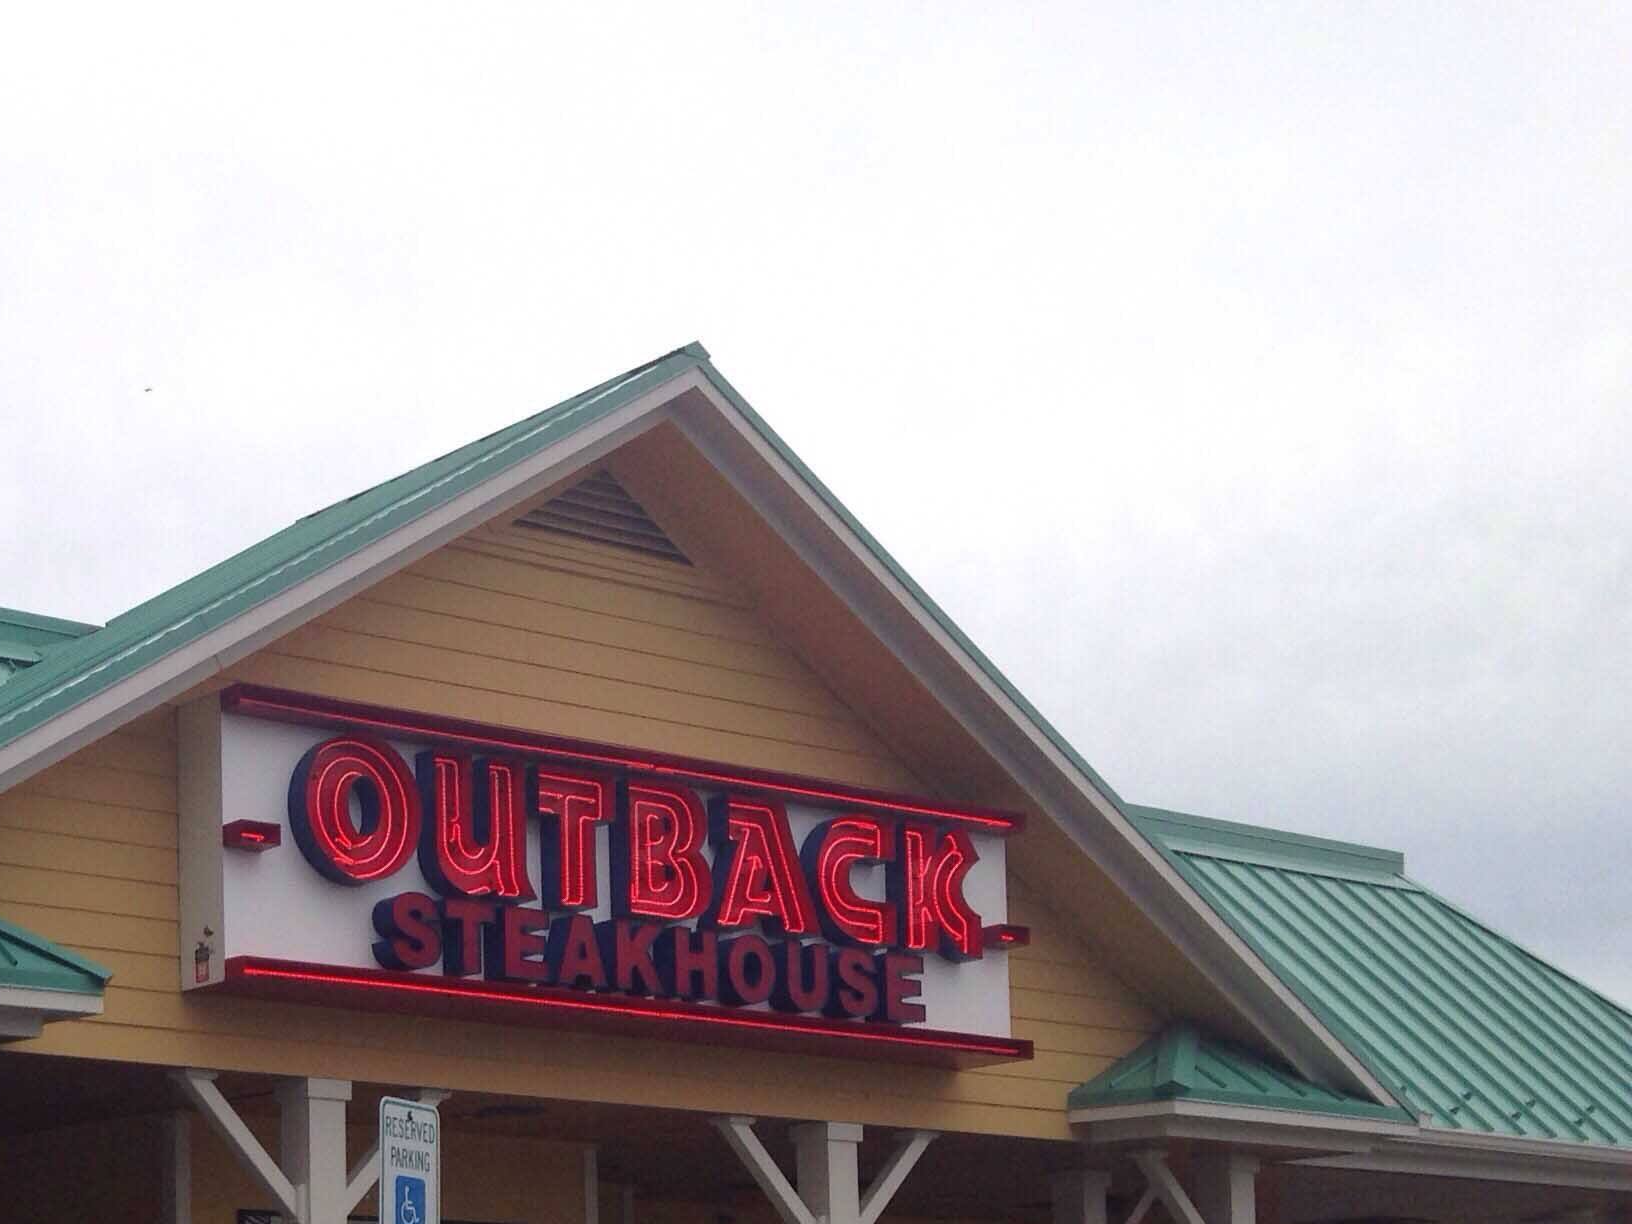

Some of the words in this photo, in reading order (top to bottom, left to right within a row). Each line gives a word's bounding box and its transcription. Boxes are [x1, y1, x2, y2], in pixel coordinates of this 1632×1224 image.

[289, 733, 982, 961] OUTBACK
[372, 891, 926, 1023] STEAKHOUSE
[385, 1115, 435, 1144] RESERVED
[390, 1146, 430, 1172] PARKING
